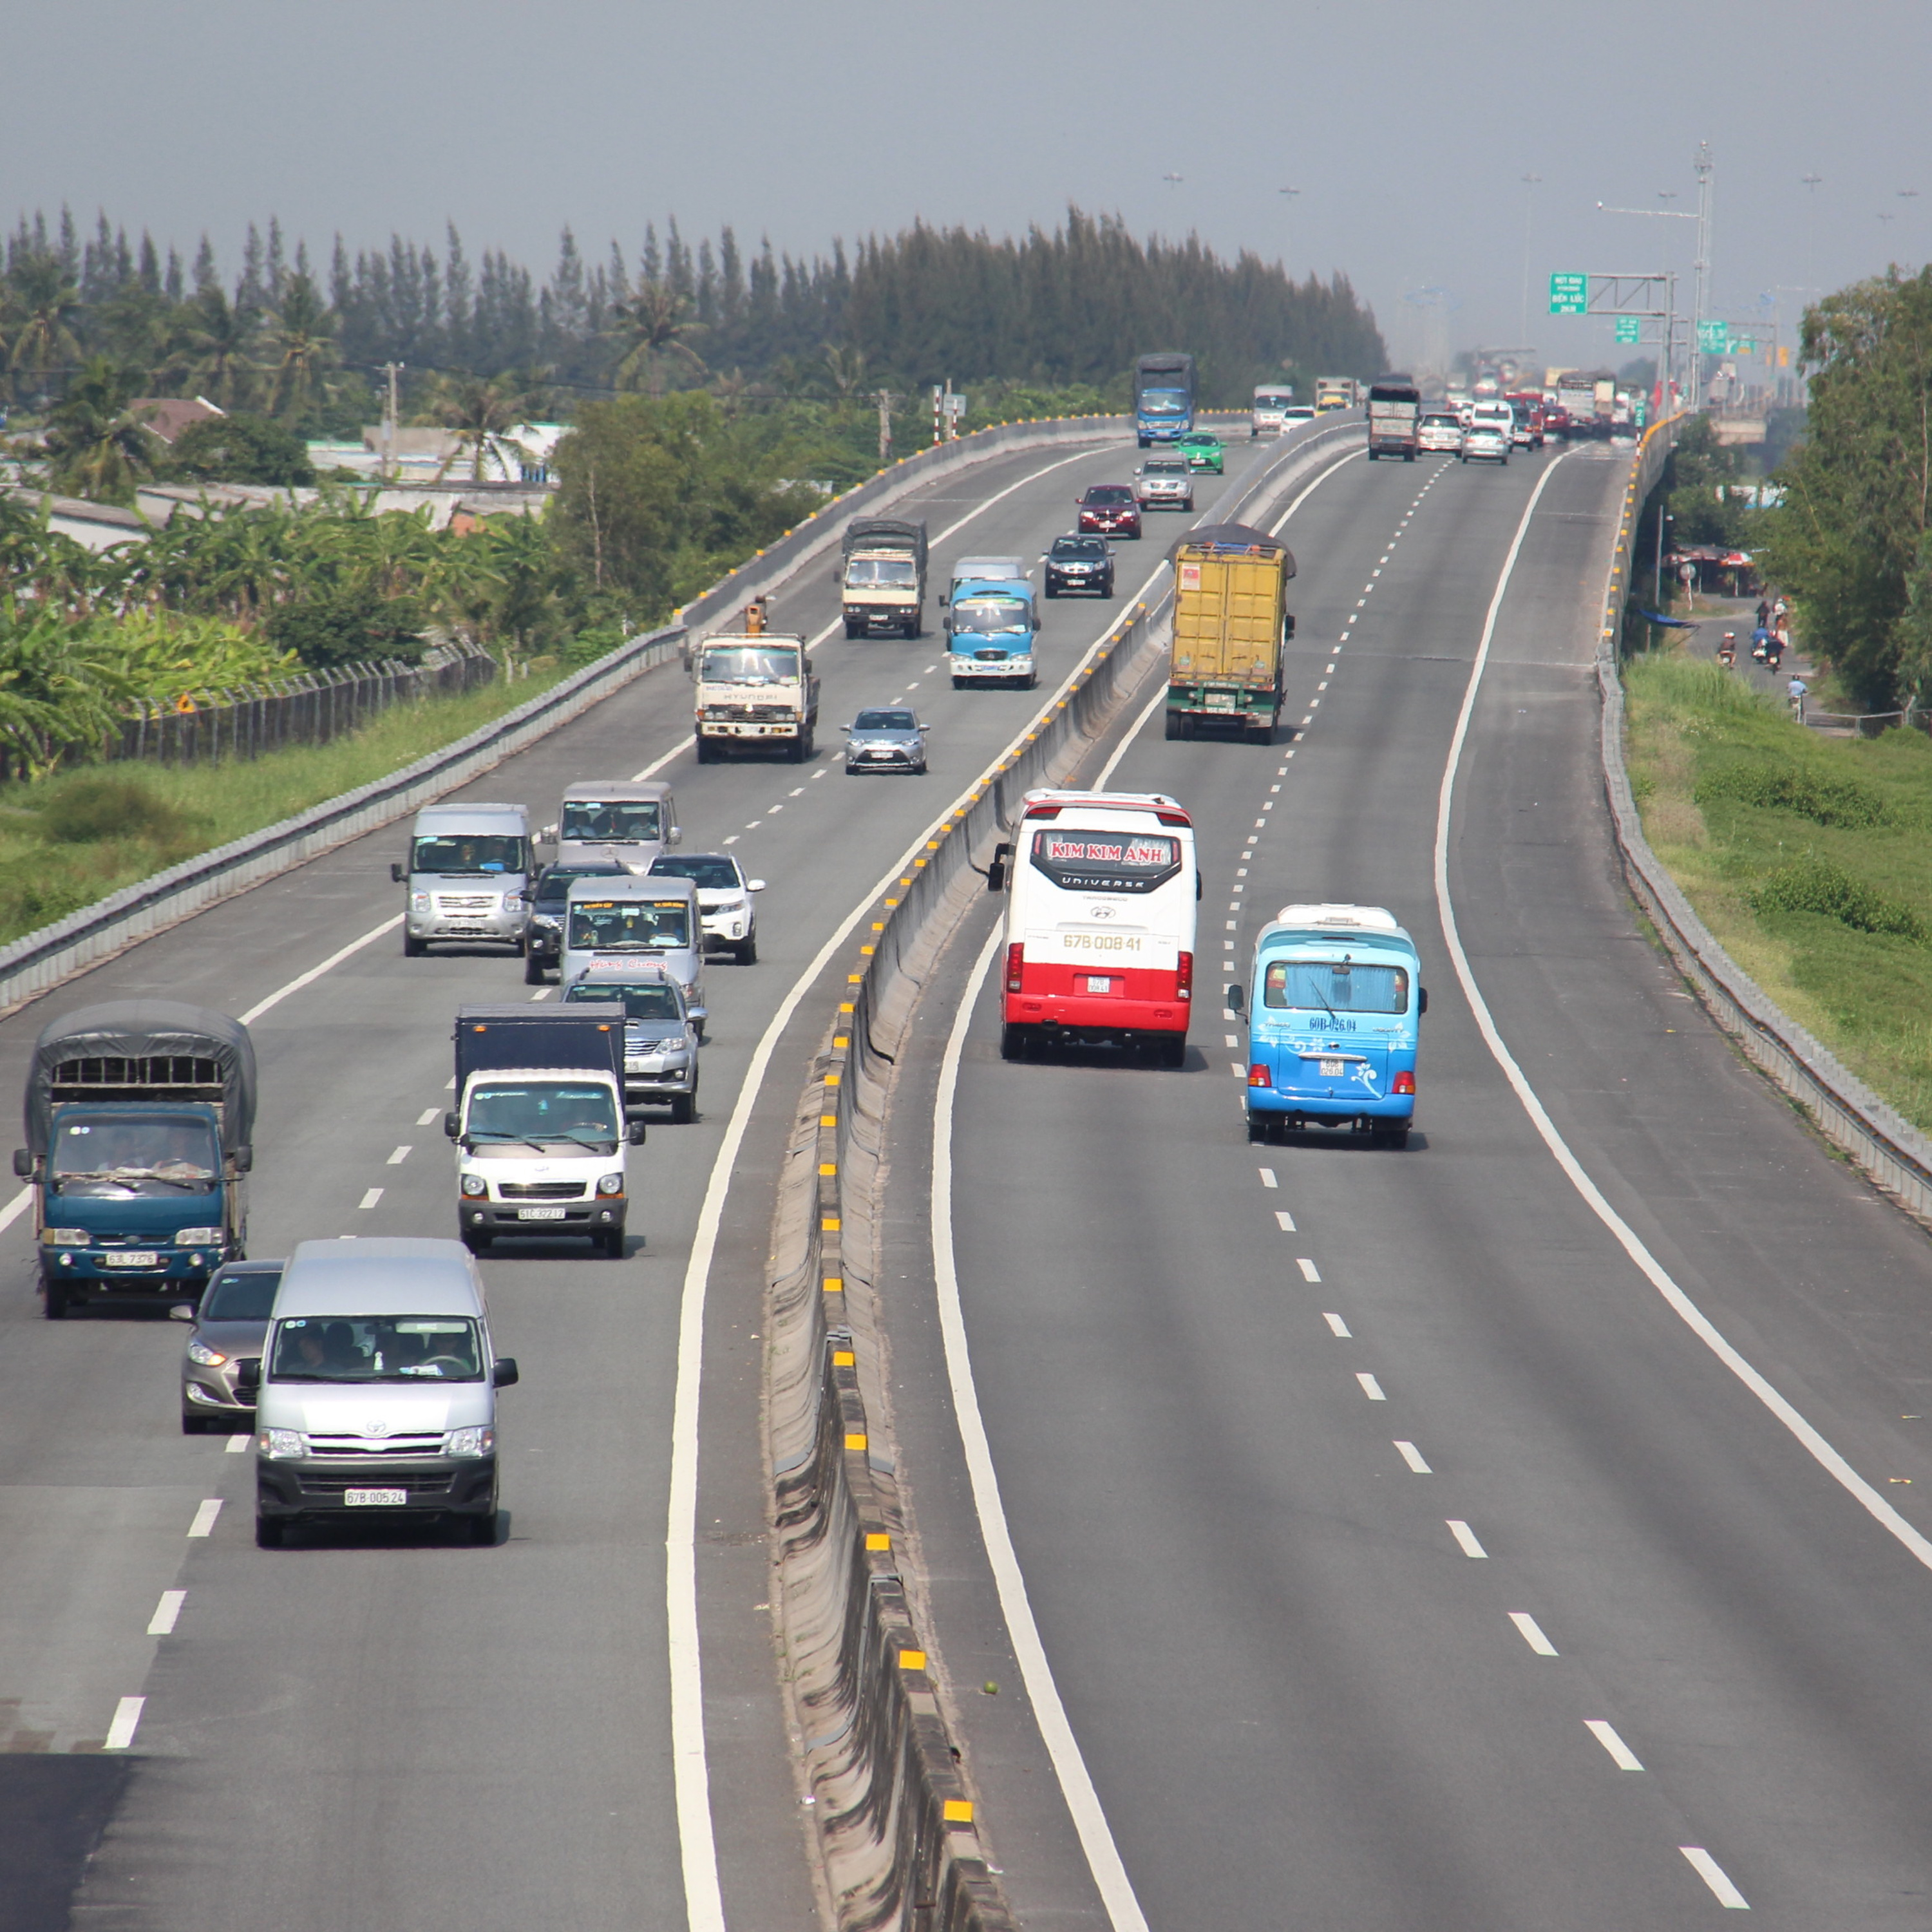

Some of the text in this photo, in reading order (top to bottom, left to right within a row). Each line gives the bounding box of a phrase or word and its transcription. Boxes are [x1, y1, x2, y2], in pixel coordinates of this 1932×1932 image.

[1051, 843, 1163, 863] KIM KIM ANH
[1062, 876, 1144, 888] UNIVERSE
